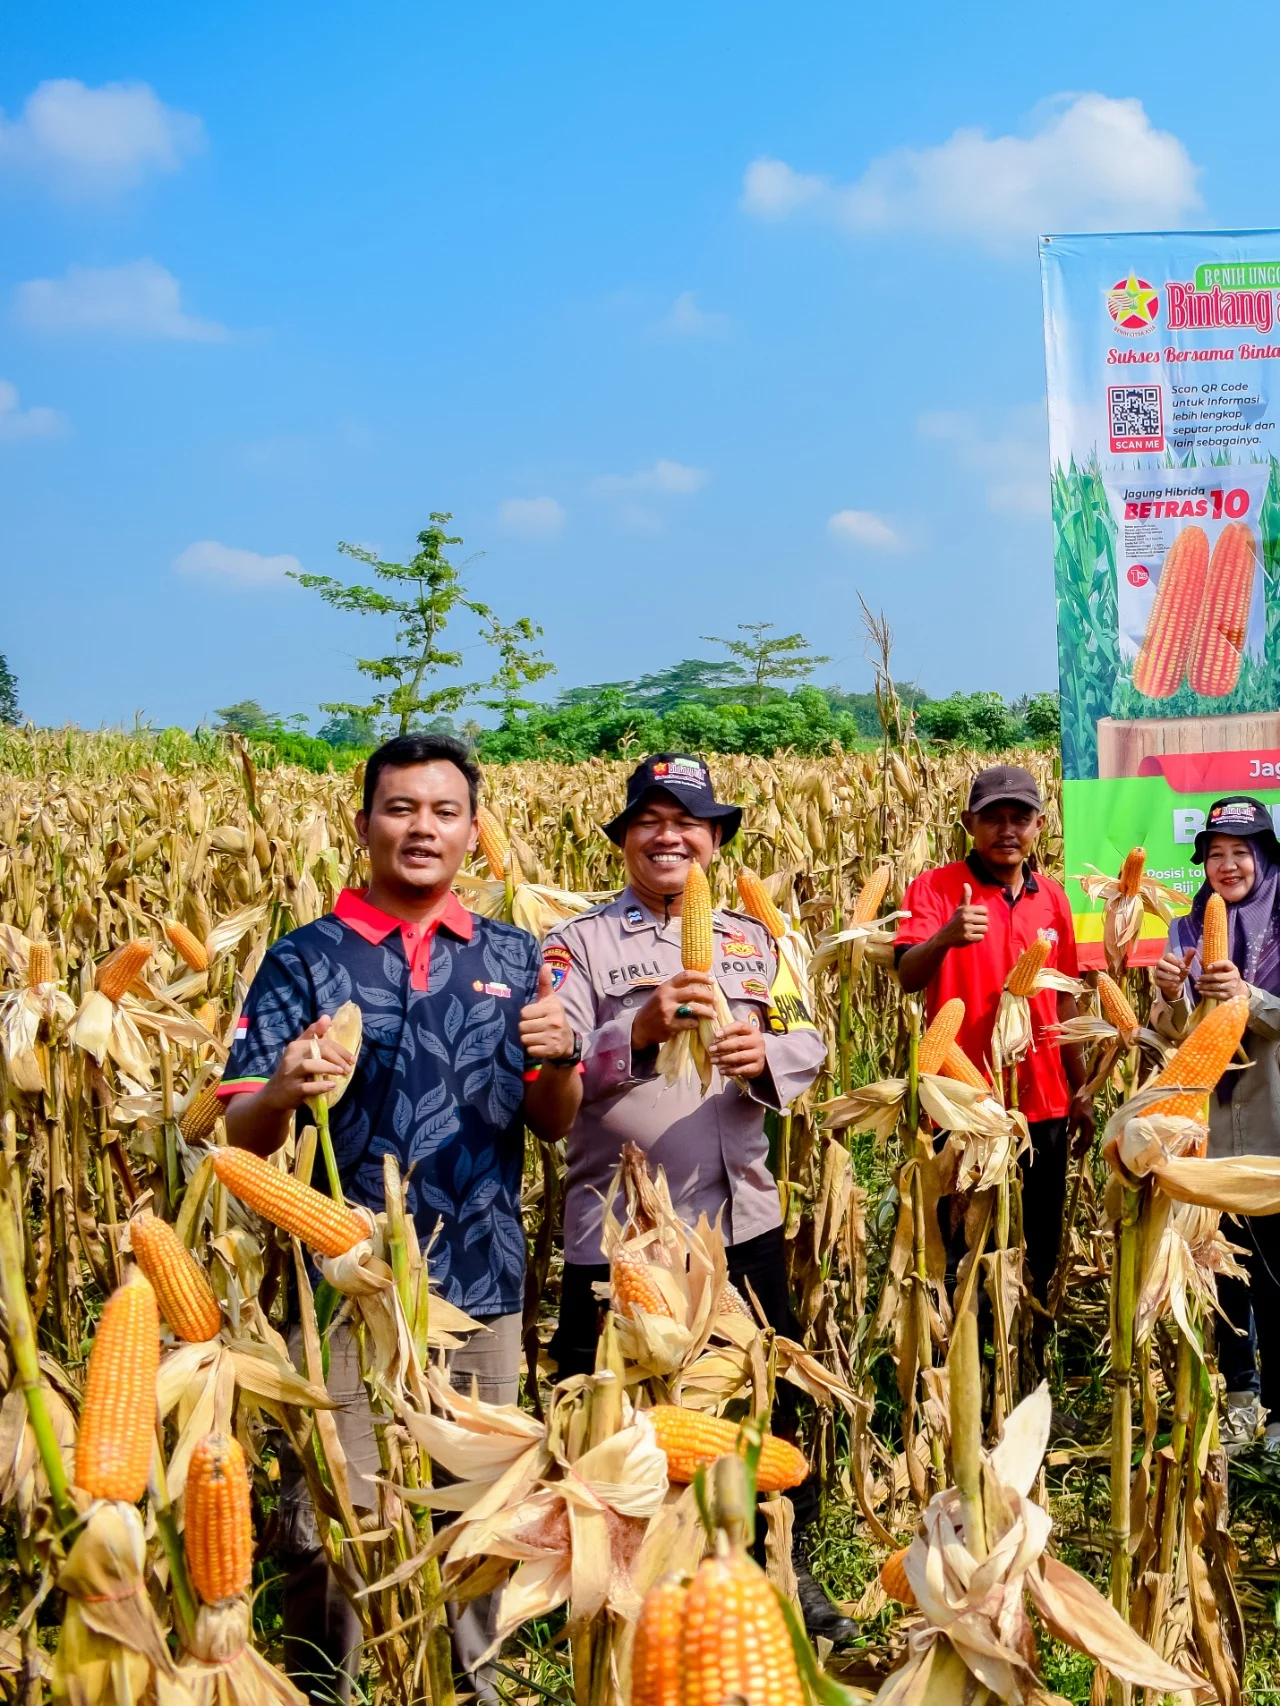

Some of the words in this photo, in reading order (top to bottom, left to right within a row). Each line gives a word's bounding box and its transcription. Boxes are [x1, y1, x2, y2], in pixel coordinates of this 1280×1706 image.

[1166, 283, 1272, 333] Bintang
[1107, 348, 1160, 365] Sukses
[1164, 346, 1234, 363] Bersama
[1172, 385, 1198, 394] Scan
[1201, 384, 1217, 393] QR
[1221, 383, 1249, 392] Code
[1172, 397, 1204, 407] untuk
[1207, 395, 1260, 406] Informasi
[1173, 411, 1198, 421] lebih
[1200, 410, 1243, 422] lengkap
[1173, 425, 1212, 435] seputar
[1215, 423, 1251, 435] produk
[1254, 421, 1276, 431] dan
[1115, 440, 1143, 450] SCAN
[1145, 440, 1160, 449] ME
[1173, 438, 1194, 448] lain
[1196, 435, 1262, 447] sebagainya.
[1124, 489, 1163, 500] Jagung
[1165, 486, 1205, 497] Hibrida
[1124, 500, 1208, 520] BETRAS
[1210, 488, 1250, 520] 10
[1173, 881, 1194, 895] Biji
[608, 960, 661, 984] FIRLI
